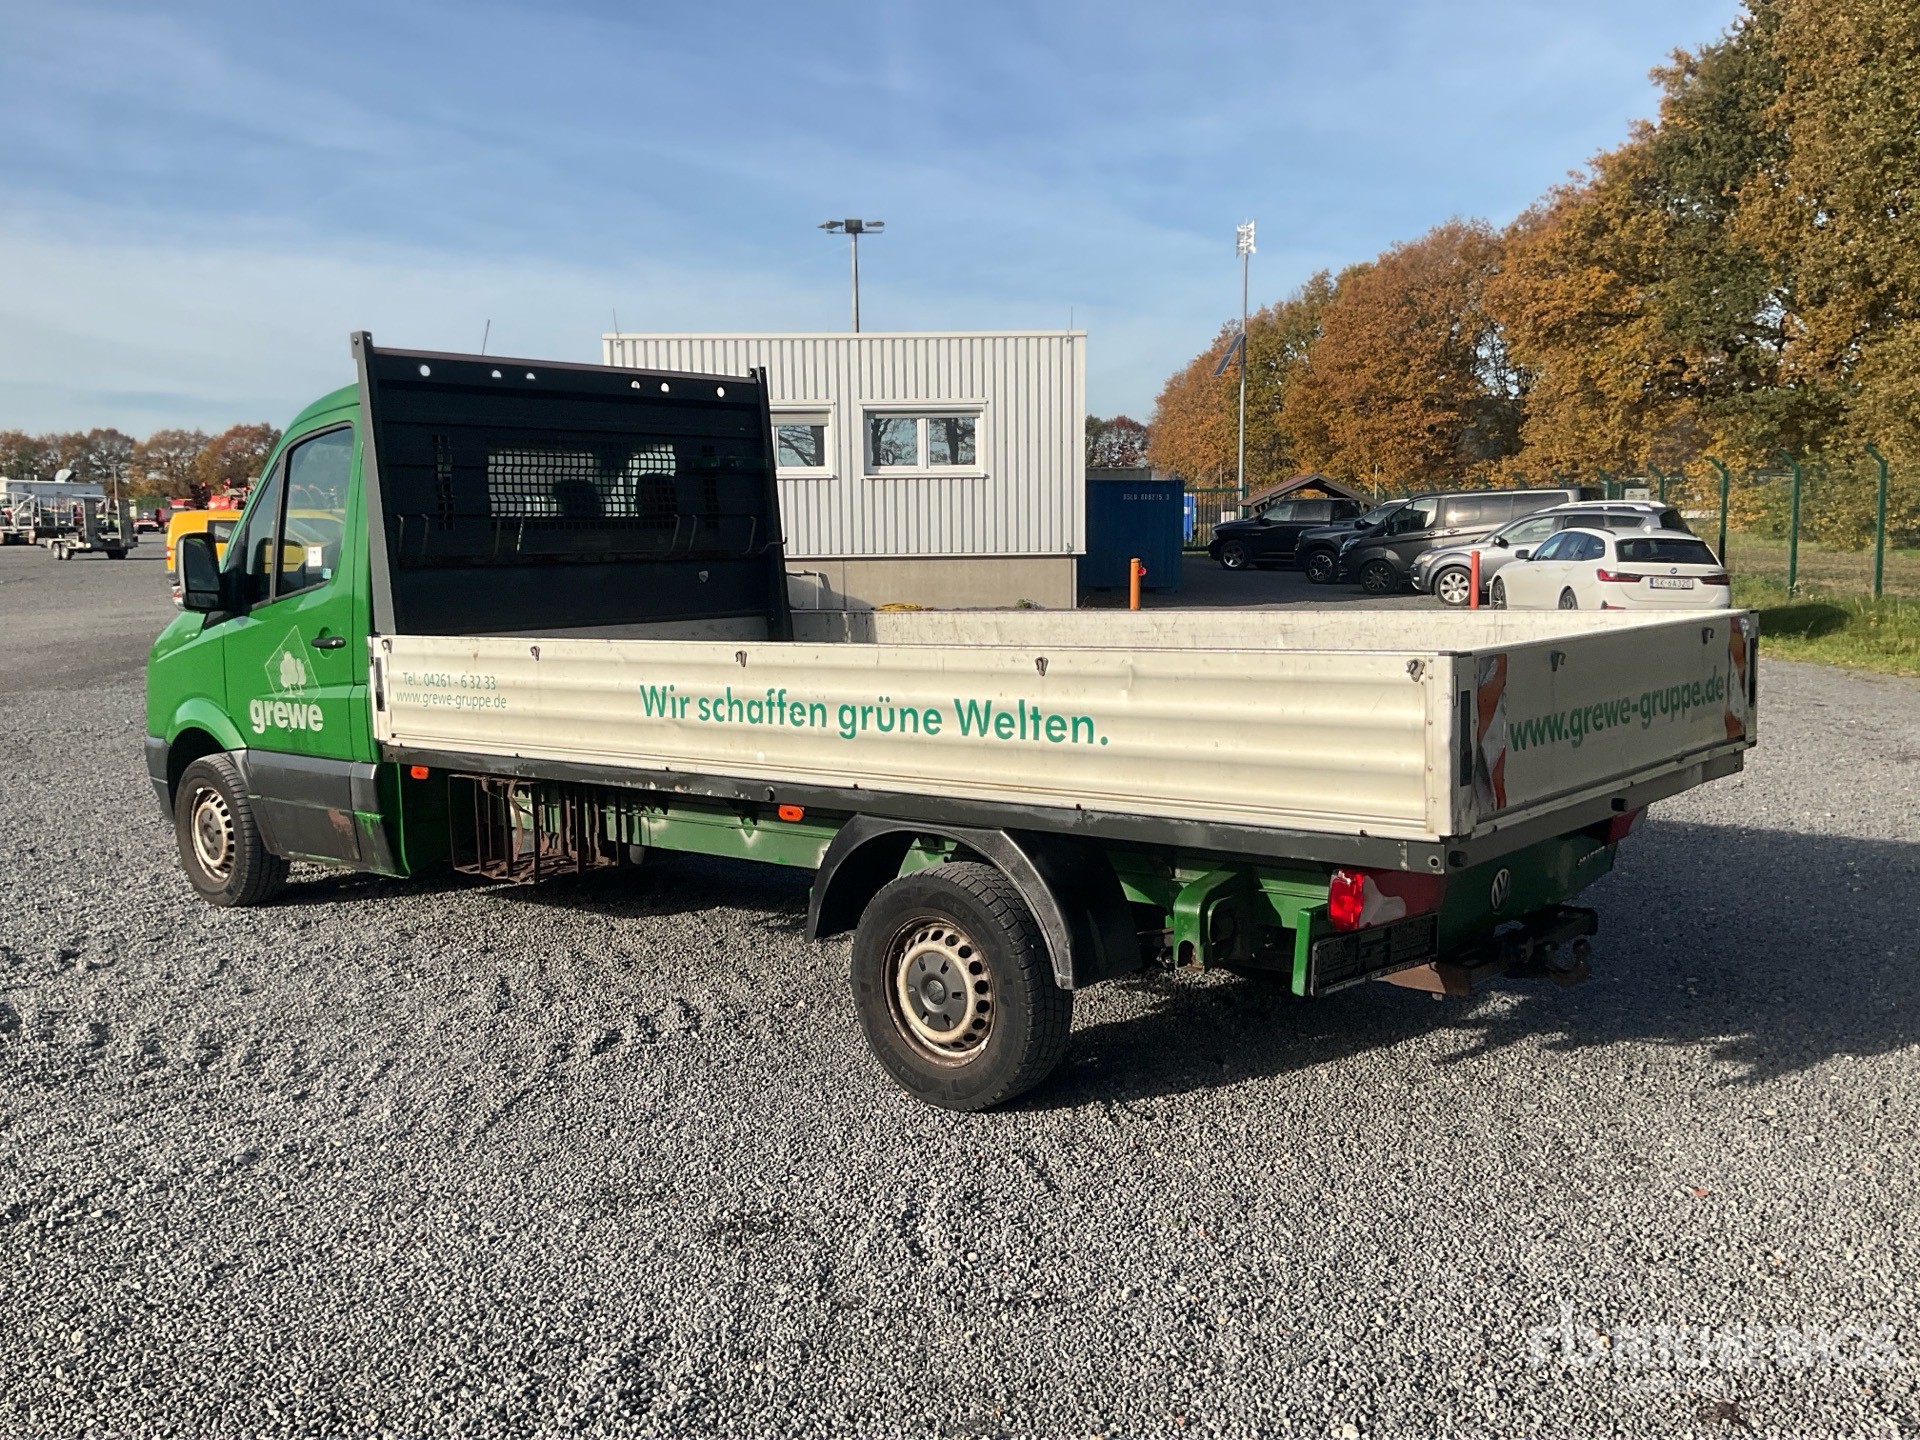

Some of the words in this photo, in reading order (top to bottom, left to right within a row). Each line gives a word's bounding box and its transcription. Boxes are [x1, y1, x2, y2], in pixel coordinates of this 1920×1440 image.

[402, 672, 422, 686] Tel.:
[423, 673, 451, 688] 04261
[484, 675, 496, 690] 33
[249, 699, 324, 734] grewe
[396, 691, 507, 710] www.grewe-gruppe.de
[639, 684, 690, 719] Wir
[698, 686, 828, 728] schaffen
[838, 696, 943, 740] grüne
[953, 698, 1109, 746] Welten.
[1509, 665, 1725, 751] www.grewe-gruppe.de
